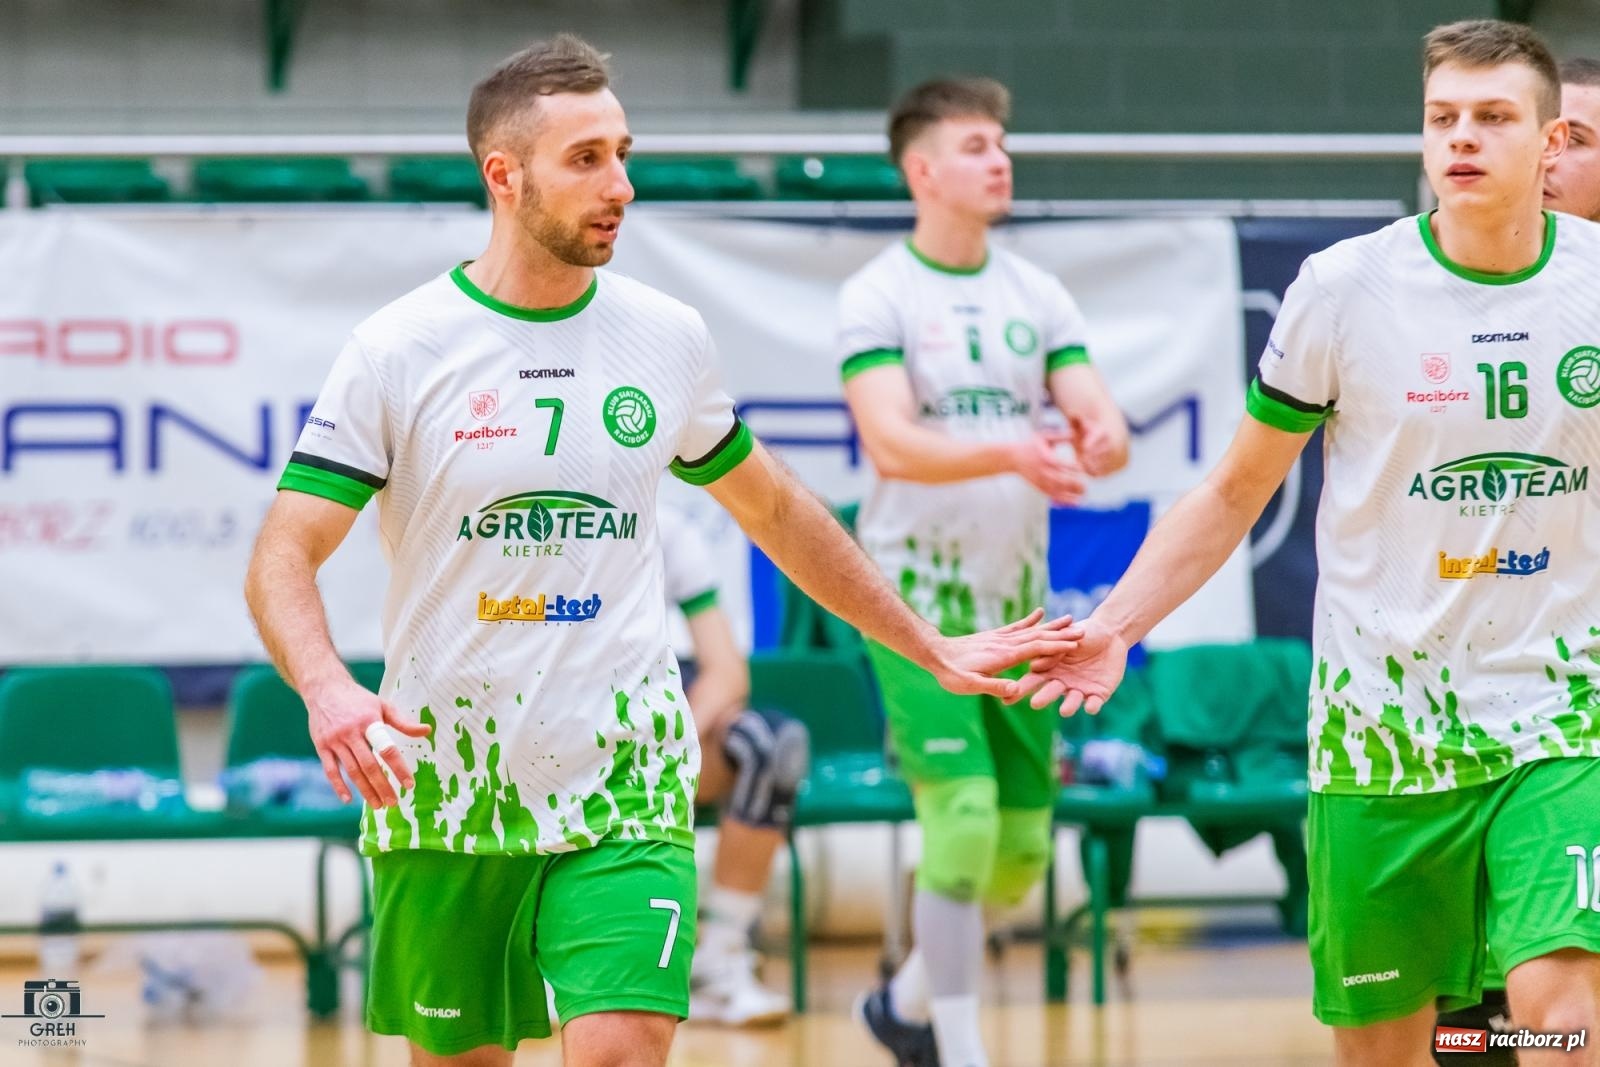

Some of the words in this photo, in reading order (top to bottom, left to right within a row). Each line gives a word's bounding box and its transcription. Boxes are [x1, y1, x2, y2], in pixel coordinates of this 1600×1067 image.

[1471, 332, 1529, 343] DECATHLON
[519, 368, 575, 379] DECATHLON
[1407, 390, 1470, 403] Racibórz
[1477, 361, 1528, 420] 16
[454, 426, 518, 442] Racibórz
[535, 397, 565, 456] 7
[457, 508, 638, 543] AGROTEAM
[503, 544, 563, 557] KIETRZ
[478, 591, 602, 621] instal-tech
[1565, 845, 1600, 913] 1
[649, 898, 681, 969] 7
[1342, 969, 1399, 987] DECATHLON
